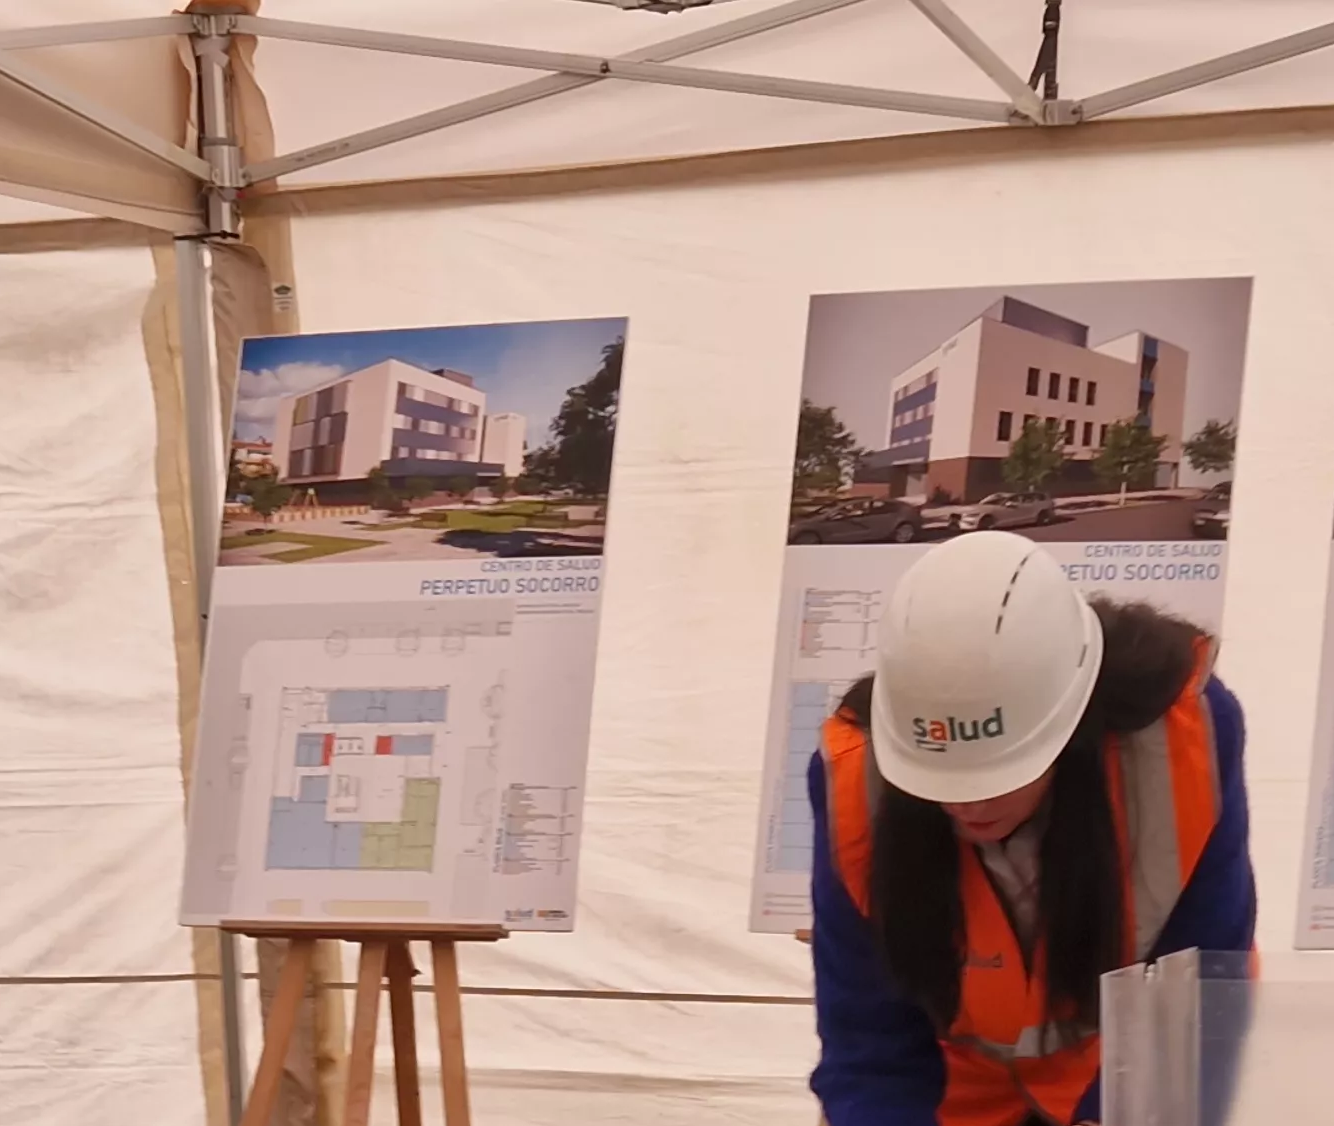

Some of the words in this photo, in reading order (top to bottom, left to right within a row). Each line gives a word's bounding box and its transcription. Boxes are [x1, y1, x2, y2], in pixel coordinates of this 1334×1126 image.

[1084, 544, 1143, 558] CENTRO
[1146, 544, 1168, 558] DE
[1171, 543, 1224, 557] SALUD
[480, 560, 533, 573] CENTRO
[535, 559, 554, 572] DE
[556, 558, 601, 571] SALUD
[1123, 563, 1221, 581] SOCORRO
[419, 578, 511, 596] PERPETUO
[514, 576, 600, 594] SOCORRO
[912, 706, 1004, 742] salud
